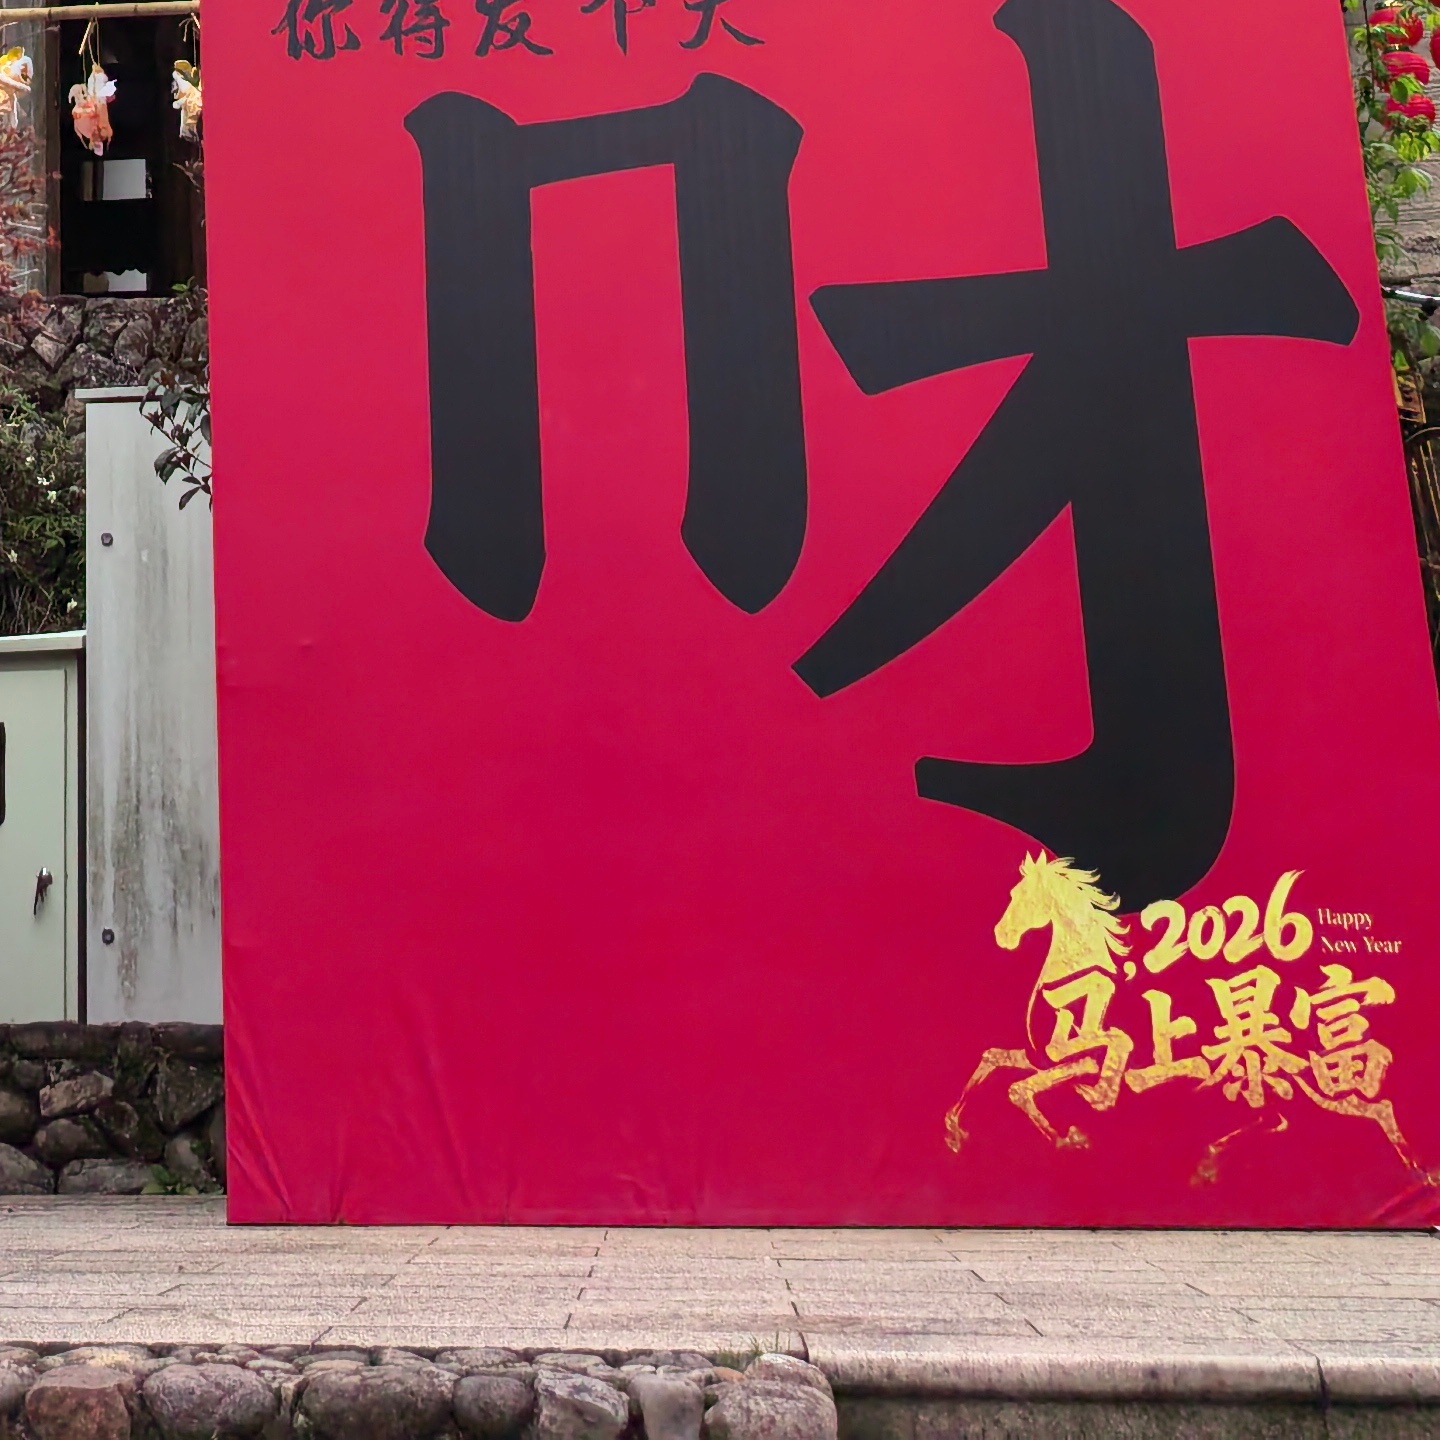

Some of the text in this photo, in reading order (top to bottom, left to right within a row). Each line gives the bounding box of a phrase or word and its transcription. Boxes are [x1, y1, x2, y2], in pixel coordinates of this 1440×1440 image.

[1139, 869, 1314, 975] 2026
[1317, 907, 1373, 931] Happy
[1320, 935, 1403, 954] New Year
[1020, 963, 1396, 1112] 马上暴富
